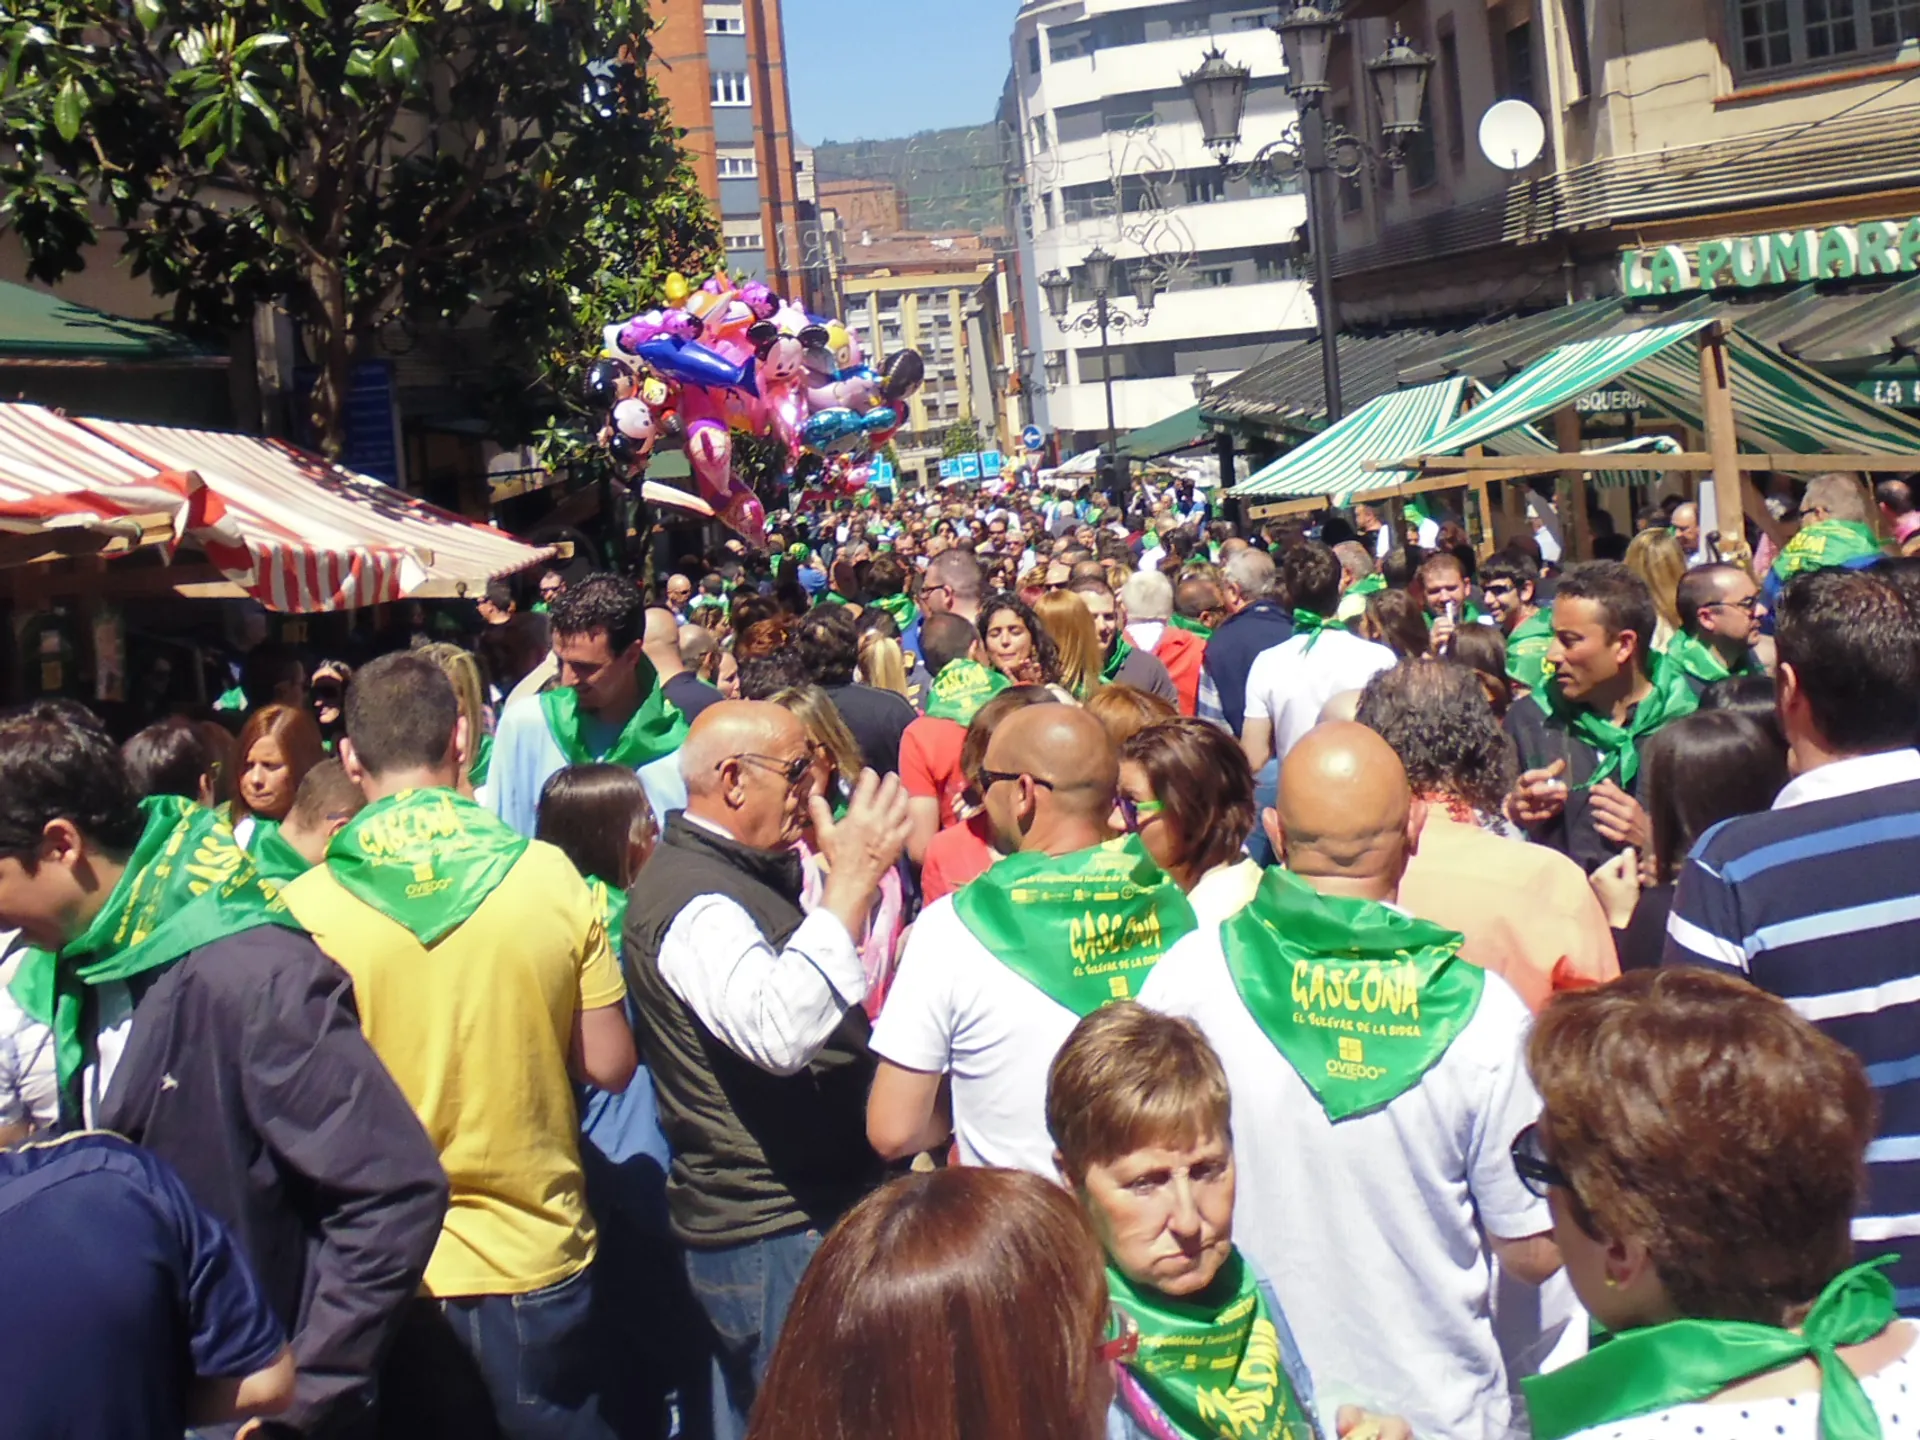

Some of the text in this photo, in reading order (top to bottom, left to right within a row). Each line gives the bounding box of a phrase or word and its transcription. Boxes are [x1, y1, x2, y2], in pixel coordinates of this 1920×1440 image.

[1621, 244, 1690, 297] LA
[1874, 380, 1902, 404] LA
[1292, 1012, 1306, 1024] EL
[1373, 1024, 1388, 1037] LA
